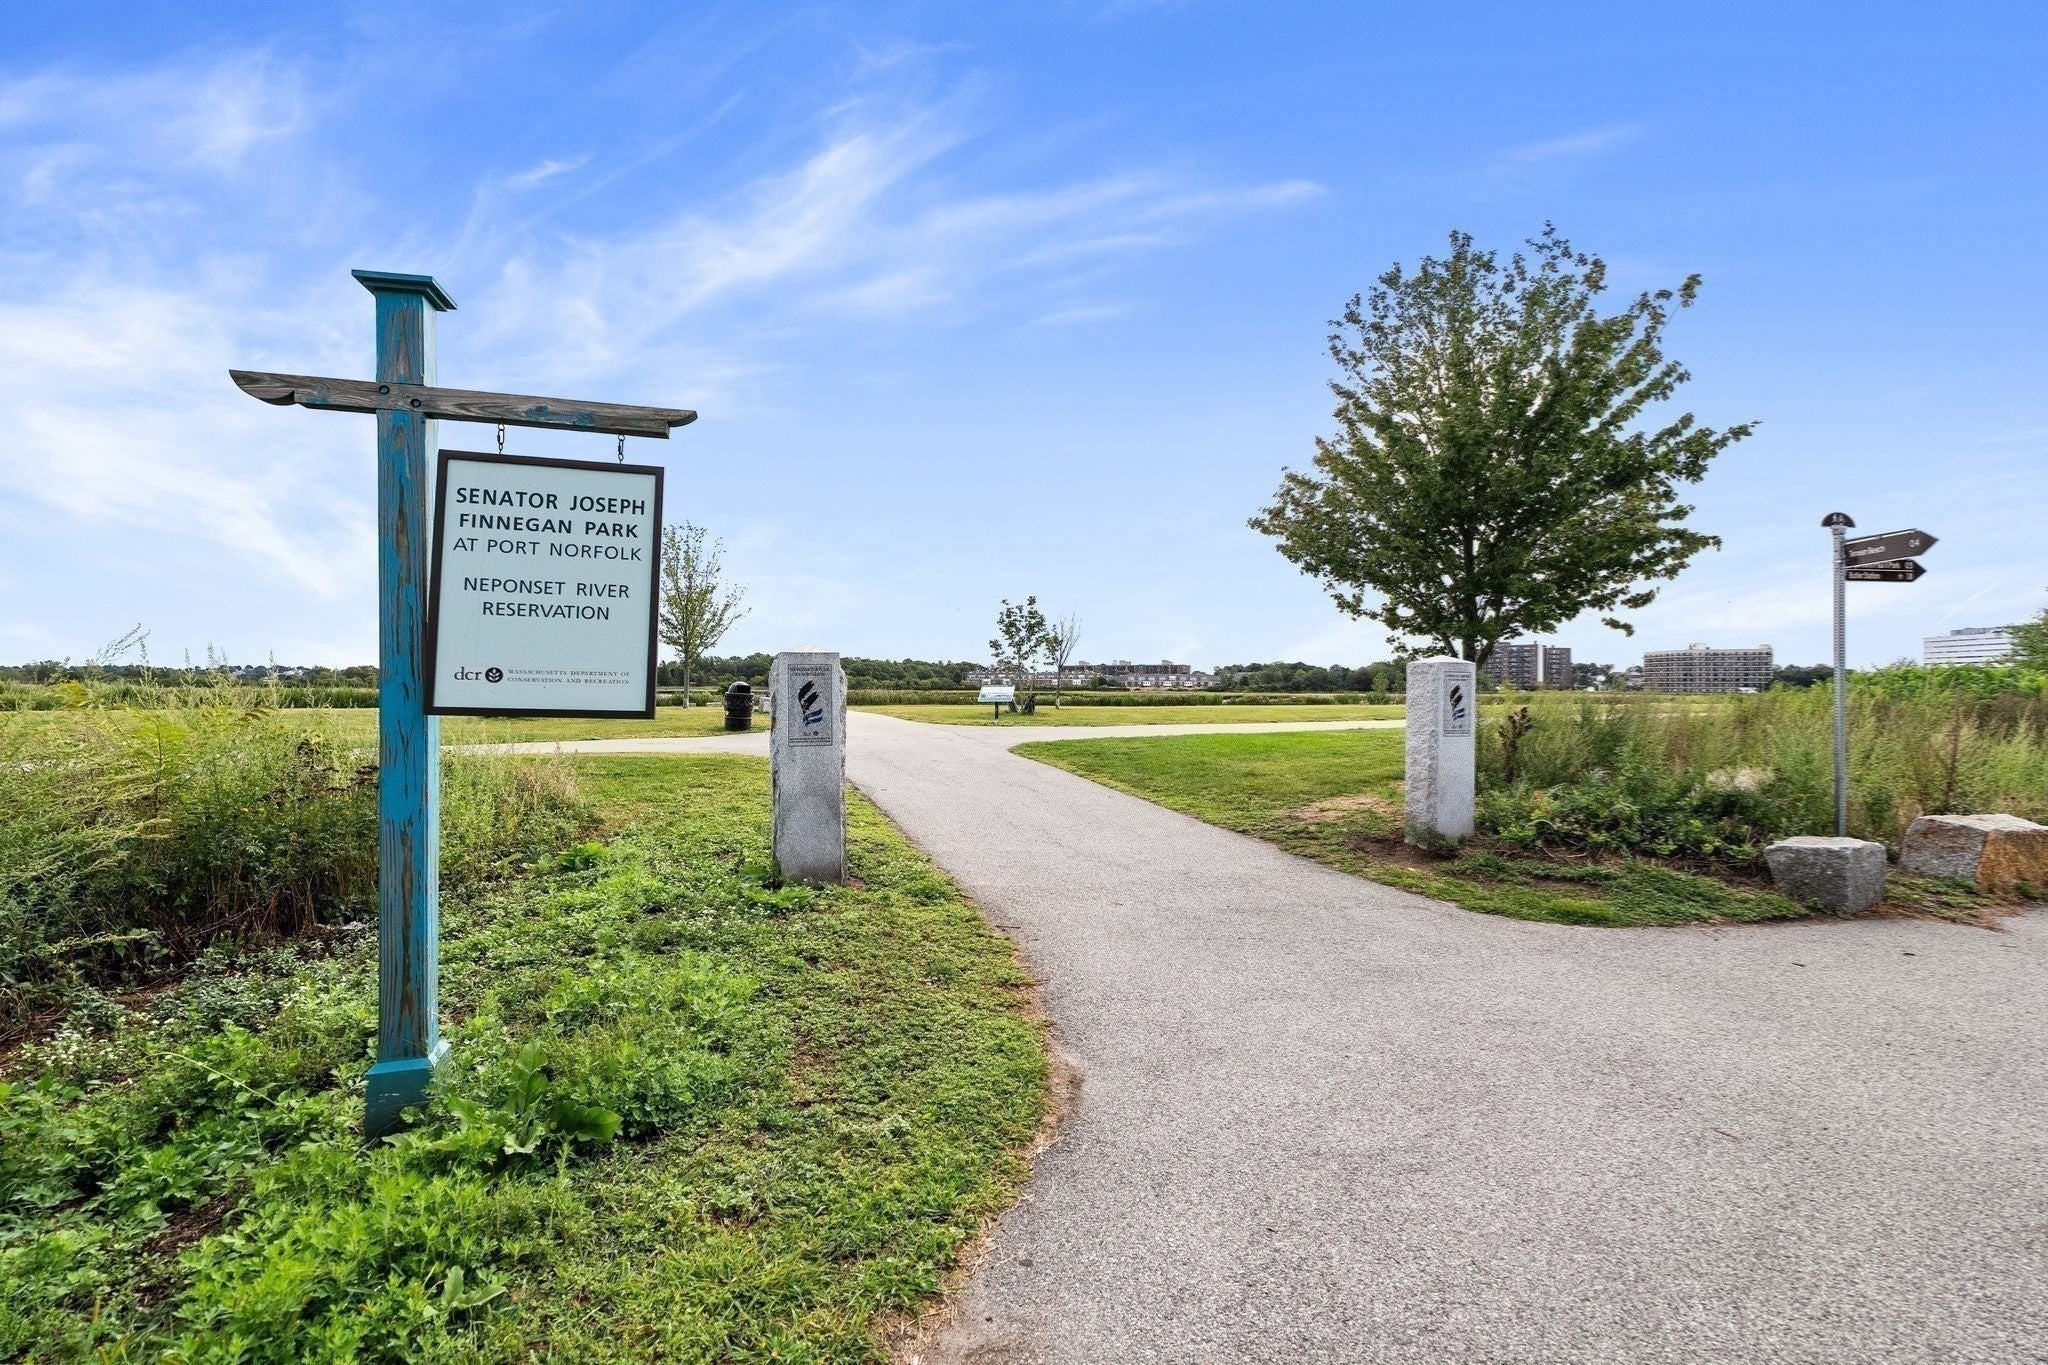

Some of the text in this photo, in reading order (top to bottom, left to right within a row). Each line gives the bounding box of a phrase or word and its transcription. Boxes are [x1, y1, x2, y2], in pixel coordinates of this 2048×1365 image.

[456, 487, 646, 516] SENATOR JOSEPH
[459, 513, 639, 539] FINNEGAN PARK
[453, 537, 642, 561] AT PORT NORFOLK
[464, 577, 630, 598] NEPONSET RIVER
[482, 601, 610, 621] RESERVATION
[453, 667, 482, 681] dcr
